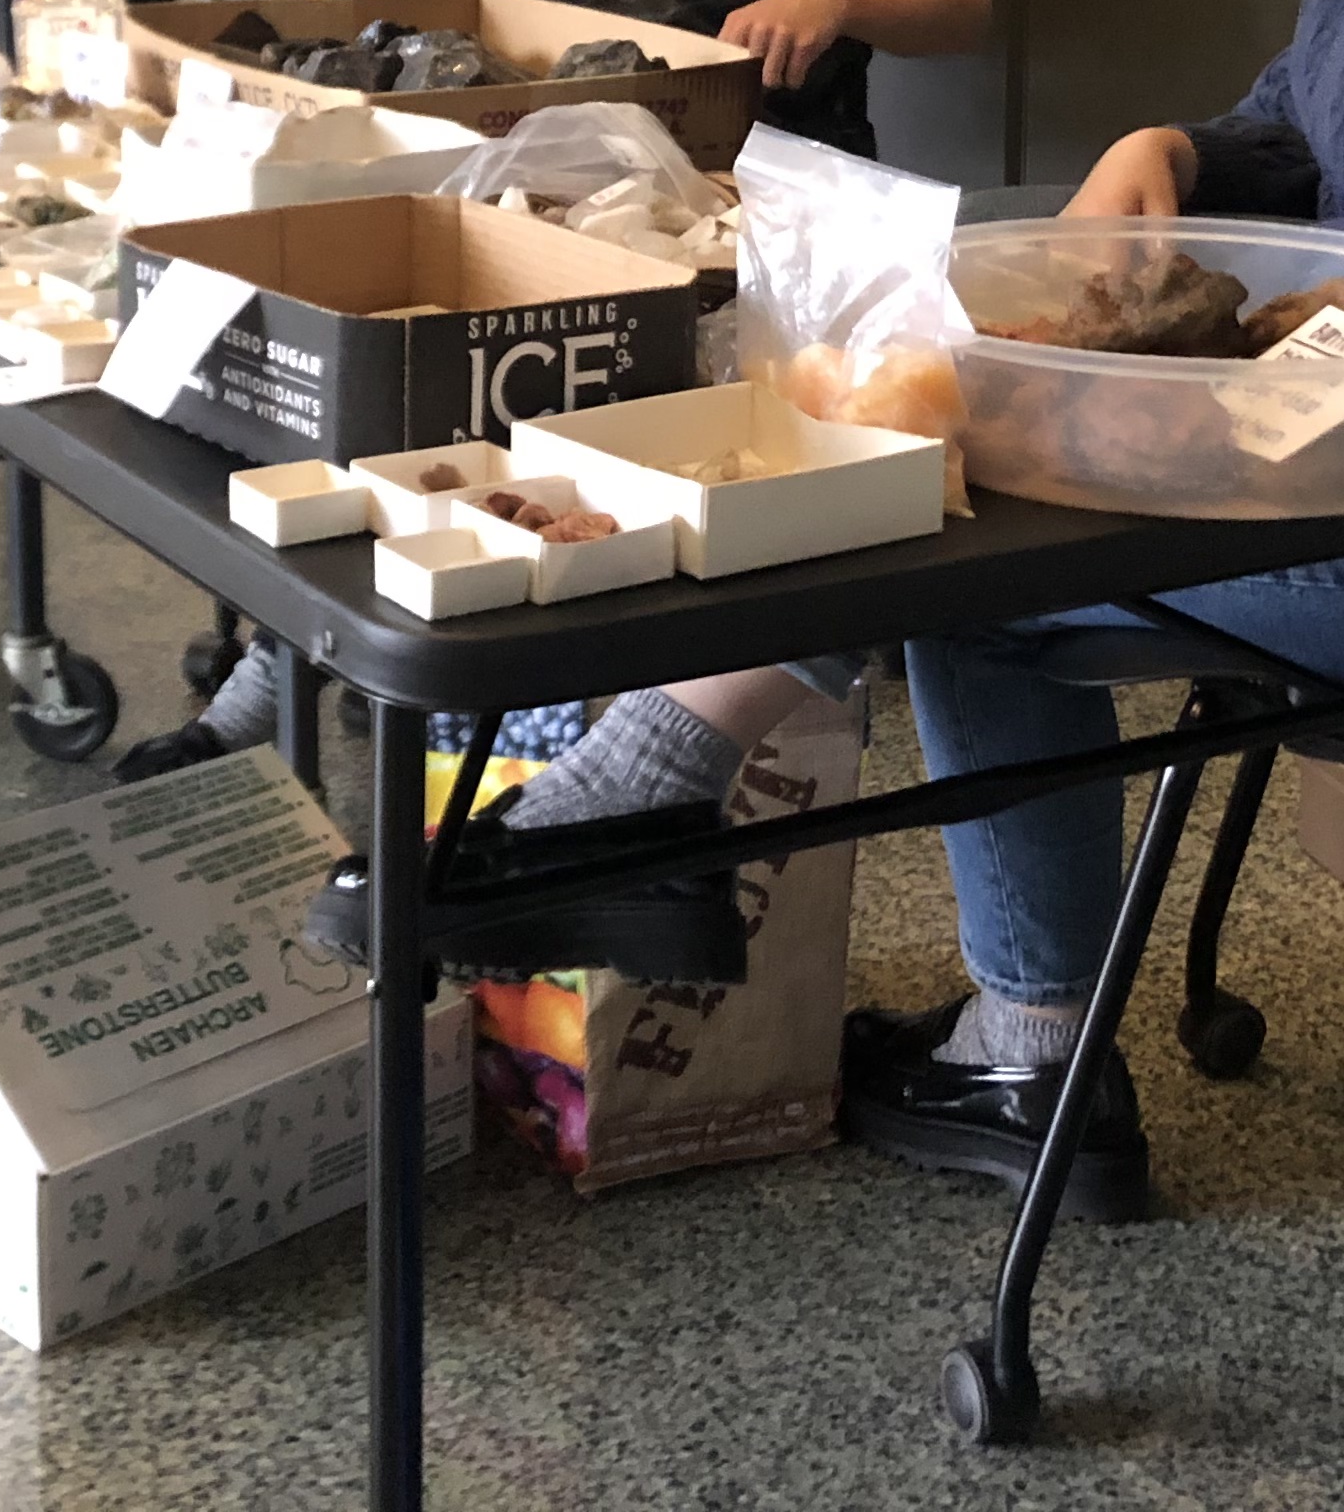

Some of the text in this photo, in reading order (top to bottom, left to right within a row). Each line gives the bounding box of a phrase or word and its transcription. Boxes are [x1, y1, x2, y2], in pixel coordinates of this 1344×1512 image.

[468, 301, 618, 339] SPARKLING
[222, 326, 262, 354] ZERO
[266, 340, 322, 377] SUGAR
[221, 364, 321, 418] ANTIOXIDANTS
[223, 389, 320, 440] AND VITAMINS
[39, 961, 251, 1059] BUTTERSTONE
[131, 991, 269, 1063] ARCHAEN
